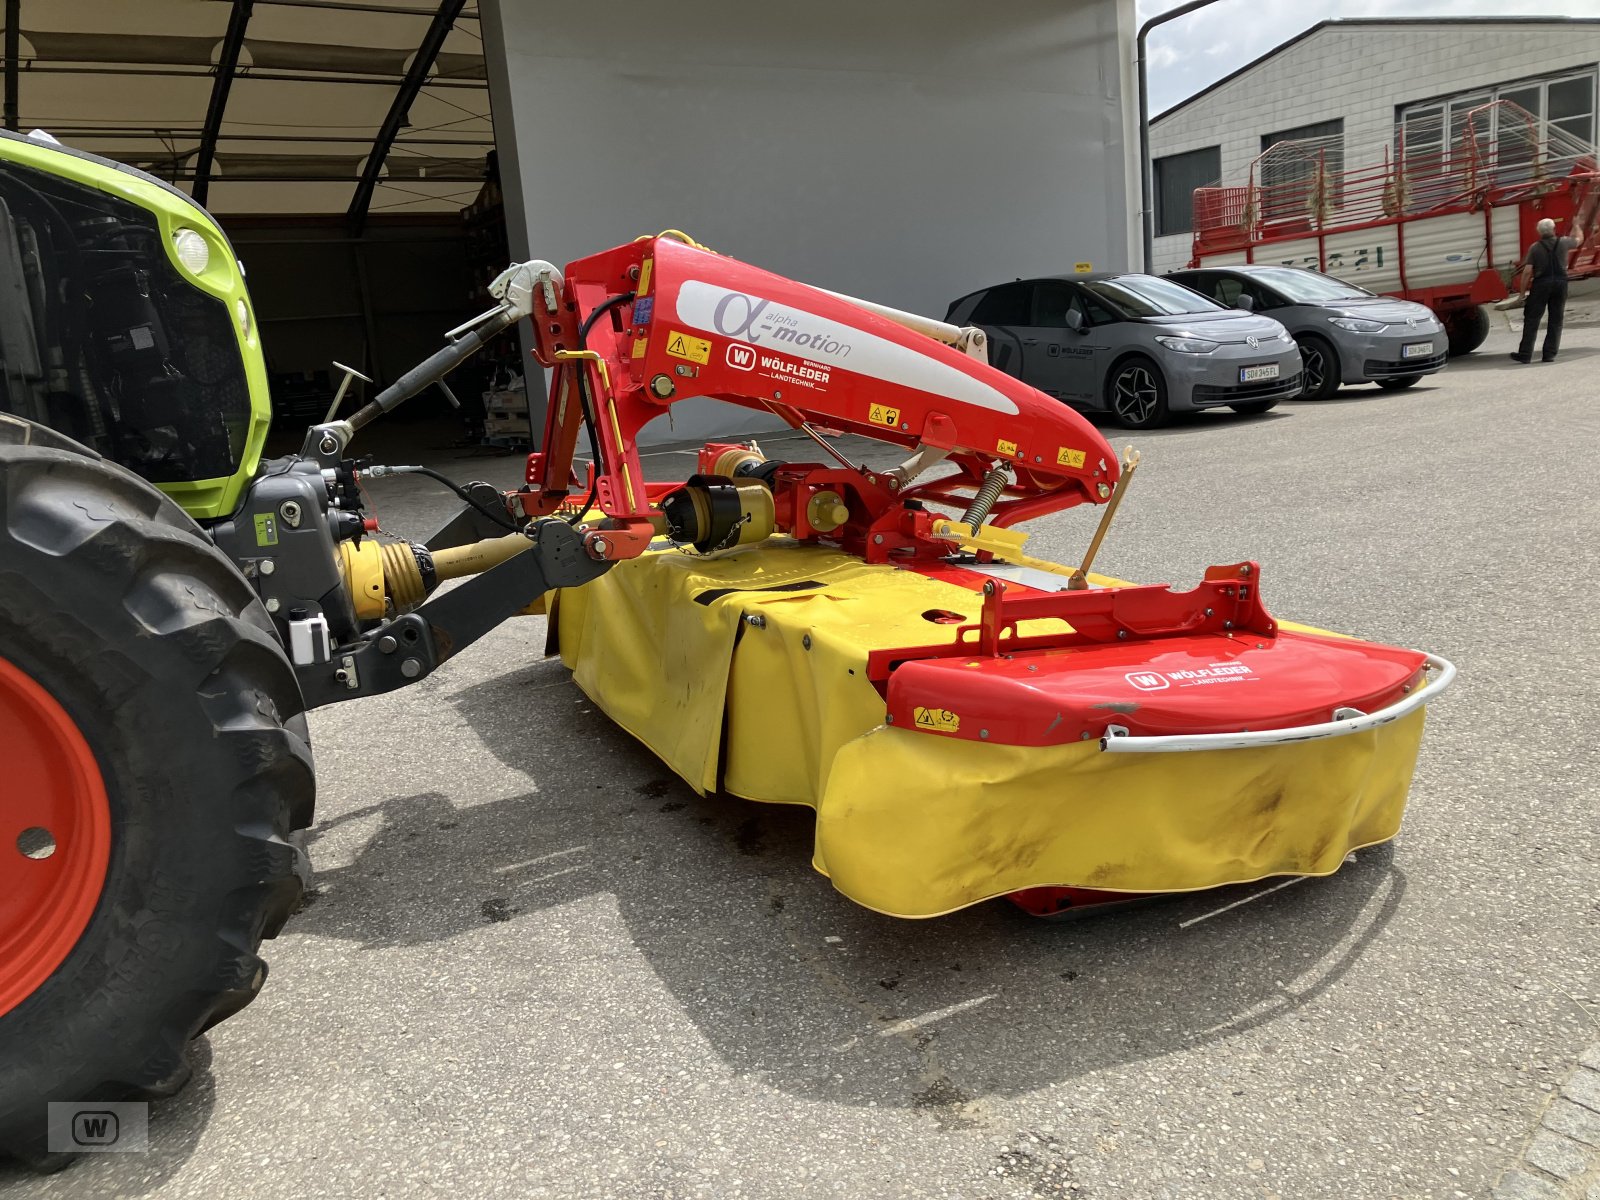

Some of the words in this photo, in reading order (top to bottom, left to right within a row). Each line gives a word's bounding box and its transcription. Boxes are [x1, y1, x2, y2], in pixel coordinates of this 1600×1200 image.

[765, 312, 799, 327] alpha
[761, 356, 830, 383] WÖLFLEDER
[803, 360, 832, 372] BERNHARD
[771, 372, 815, 389] LANDTECHNIK
[1167, 666, 1253, 681] WÖLFLEDER
[1191, 675, 1246, 686] LANDTECHNIK
